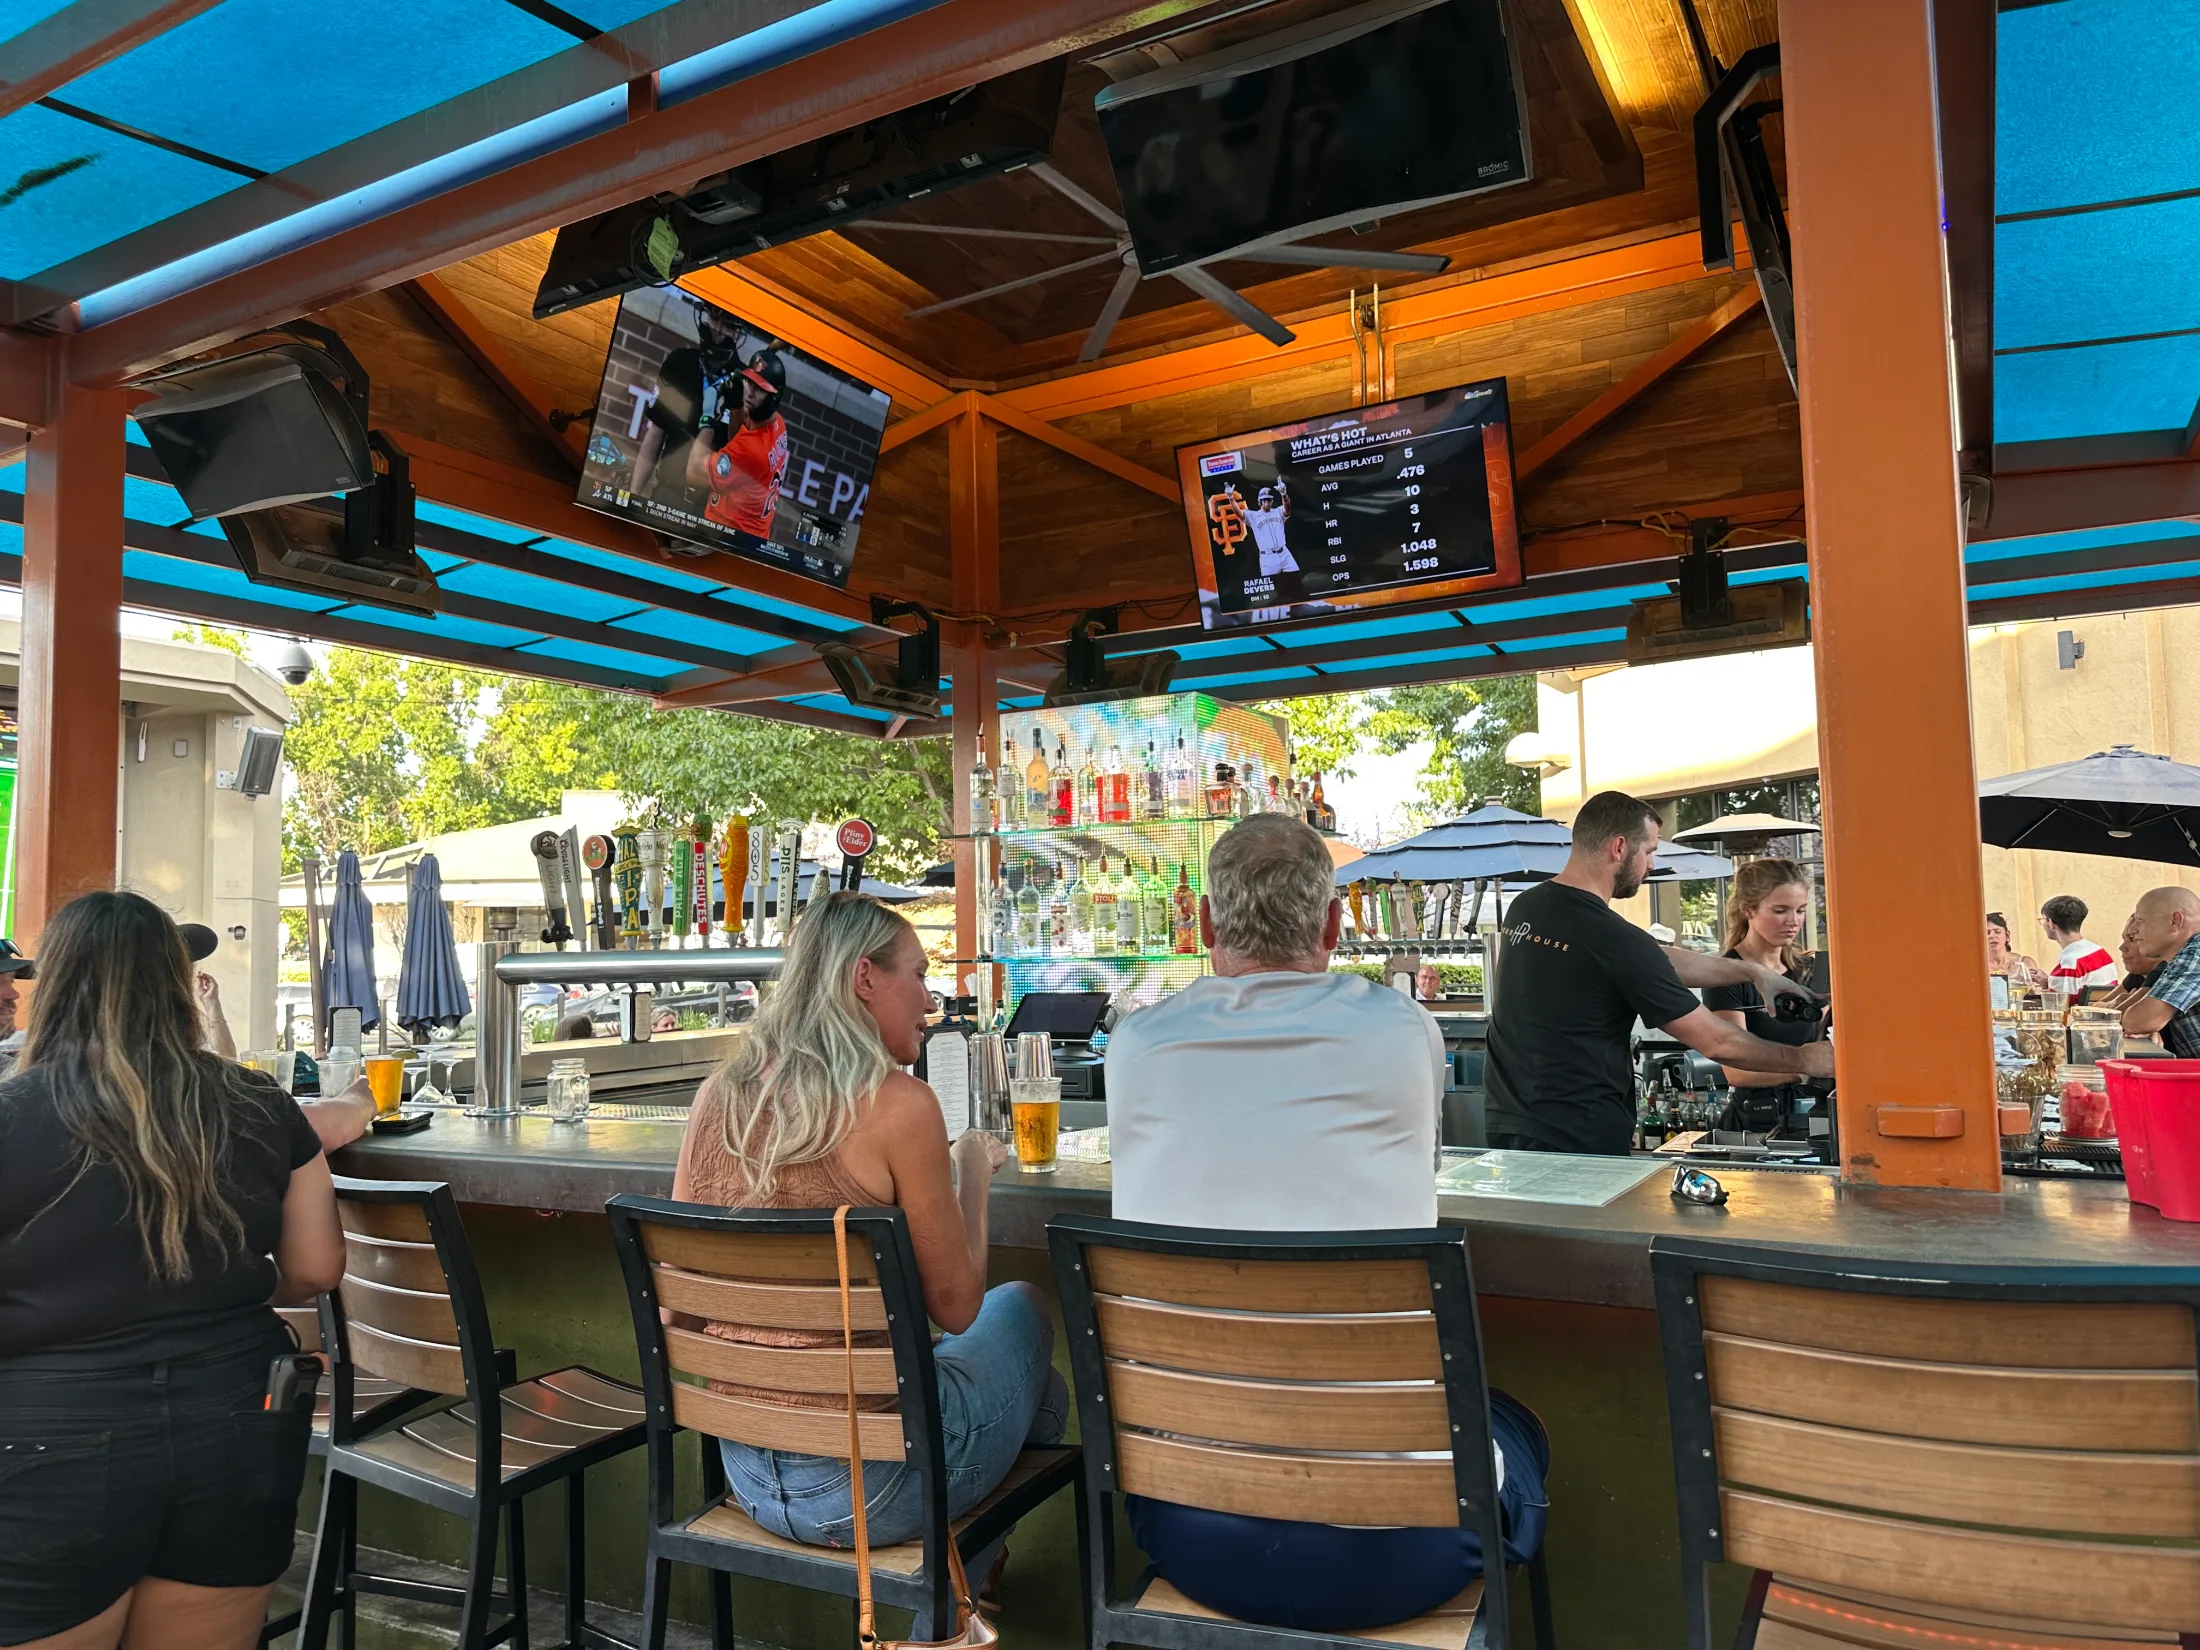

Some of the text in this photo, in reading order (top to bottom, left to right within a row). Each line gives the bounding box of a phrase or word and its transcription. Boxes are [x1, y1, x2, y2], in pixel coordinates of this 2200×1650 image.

[1478, 161, 1509, 175] BROMIC
[1290, 427, 1367, 451] WHAT'S HOT
[1291, 445, 1322, 458] CAREER
[1323, 443, 1334, 452] AS
[1341, 438, 1365, 448] GIANT
[1375, 428, 1412, 441] ATLANTA
[1318, 447, 1413, 474] GAMES PLAYED 5
[604, 485, 613, 493] SF
[1321, 464, 1425, 492] AVG .476
[602, 492, 613, 502] ATL
[1323, 484, 1420, 510] H 10
[649, 508, 663, 517] SUCH
[663, 513, 681, 524] STREAK
[686, 520, 698, 529] MAY
[656, 503, 667, 512] 2ND
[667, 506, 687, 519] 3-GAME
[687, 513, 697, 523] WIN
[697, 516, 717, 529] STREAK
[1325, 503, 1420, 529] HR 3
[1327, 522, 1421, 546] RBI 7
[1330, 538, 1437, 564] SLG 1.048
[1332, 557, 1439, 581] OPS 1.598
[1244, 577, 1273, 588] RAFAEL
[1244, 583, 1275, 595] DEVERS
[844, 827, 865, 840] Pliny
[845, 836, 868, 848] Elder
[546, 864, 557, 896] LIGHT
[675, 852, 684, 918] PALE ALE
[694, 853, 707, 923] DESCHUTES
[1526, 933, 1570, 952] HOUSE
